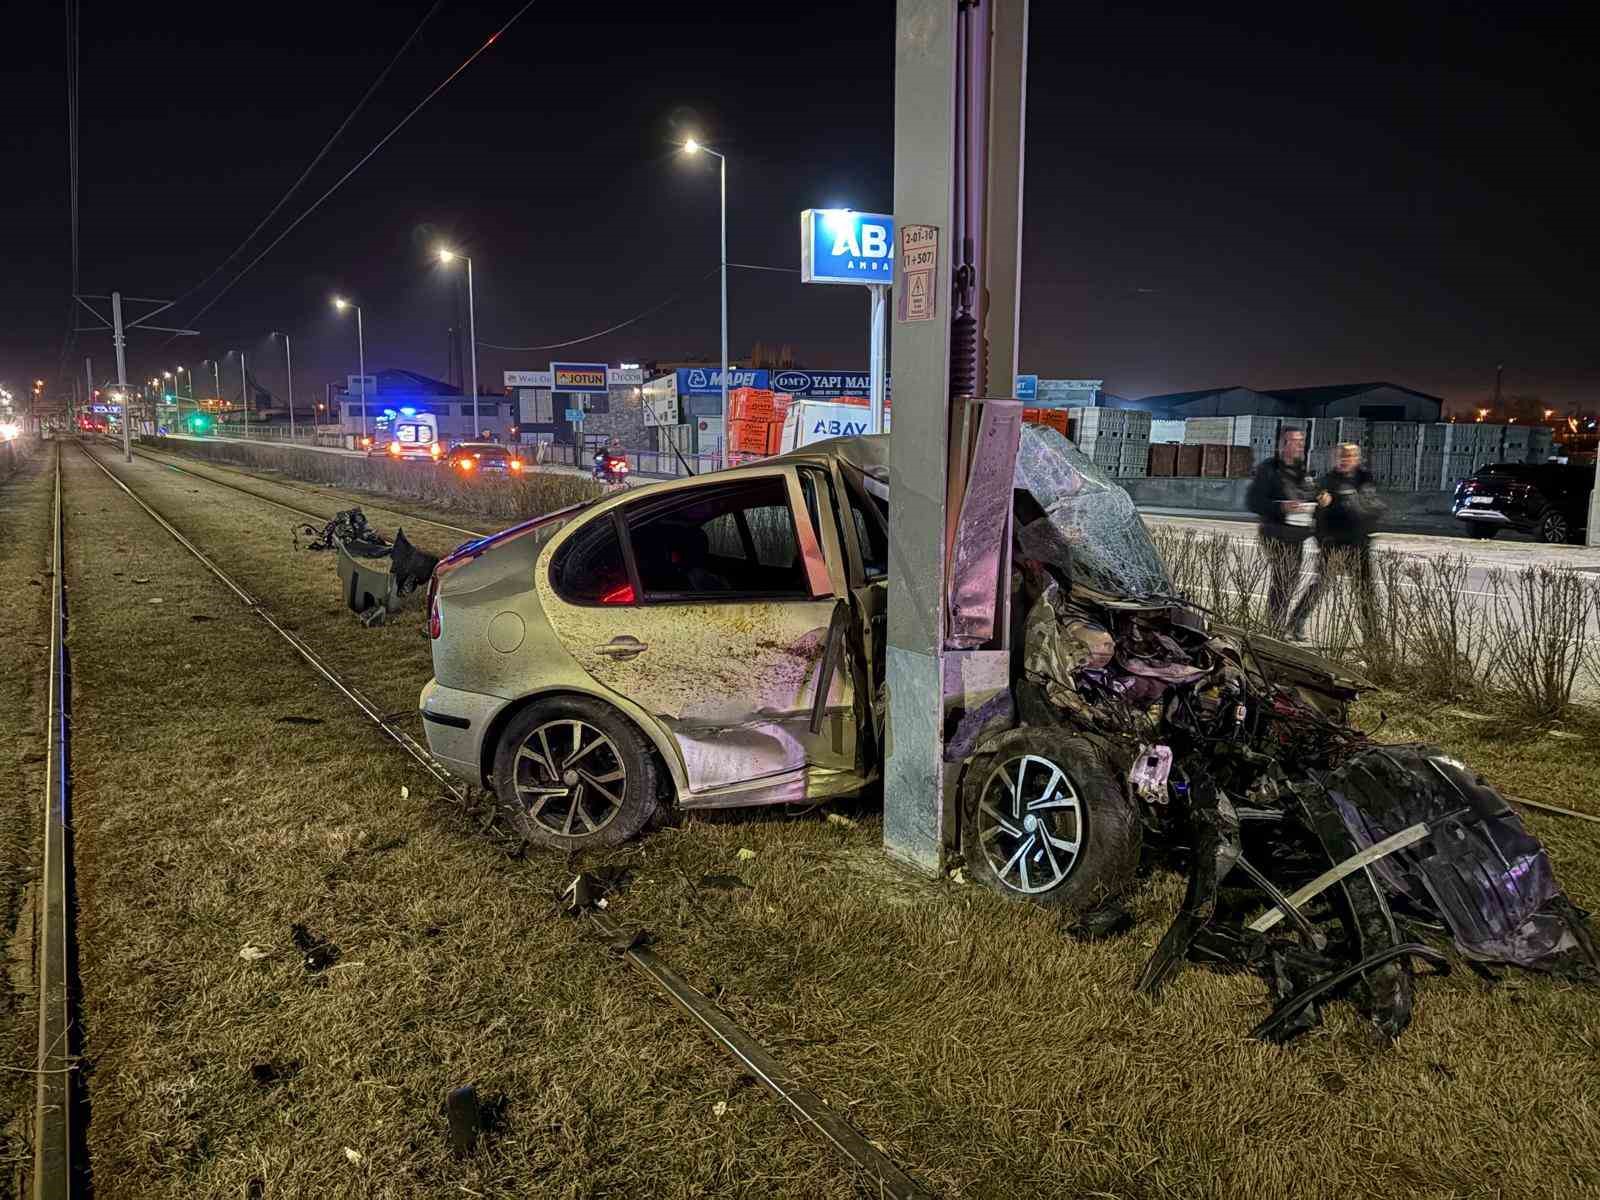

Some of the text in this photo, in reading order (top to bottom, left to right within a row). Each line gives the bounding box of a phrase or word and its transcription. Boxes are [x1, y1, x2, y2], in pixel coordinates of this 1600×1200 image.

[832, 222, 894, 259] AB
[569, 374, 603, 385] JOTUN
[709, 372, 756, 387] MAPEI
[811, 376, 842, 388] YAPI
